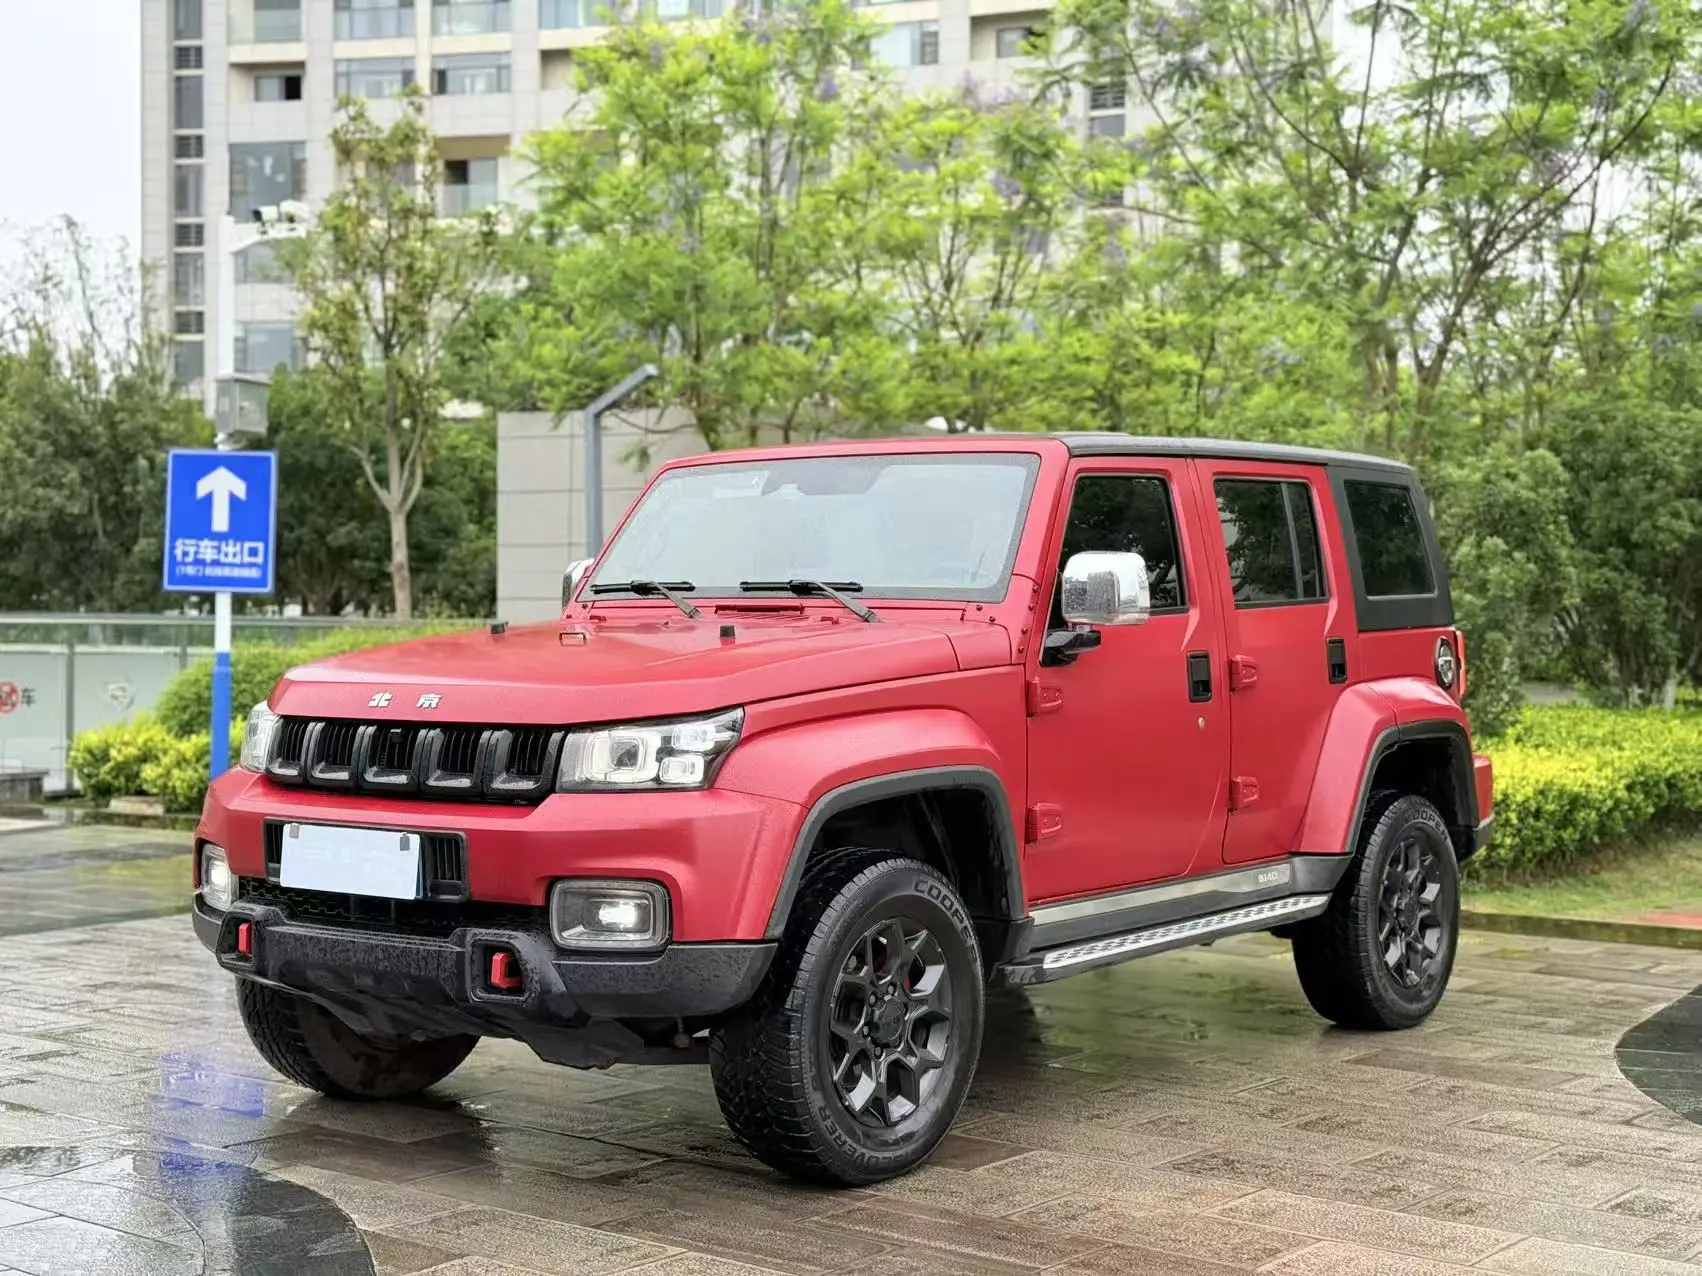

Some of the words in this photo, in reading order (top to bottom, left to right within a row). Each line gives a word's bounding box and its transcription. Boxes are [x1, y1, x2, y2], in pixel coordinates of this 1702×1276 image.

[174, 538, 264, 564] 行车出口
[368, 692, 443, 708] 北京
[1404, 808, 1448, 843] OOPER
[914, 879, 977, 962] COOPER
